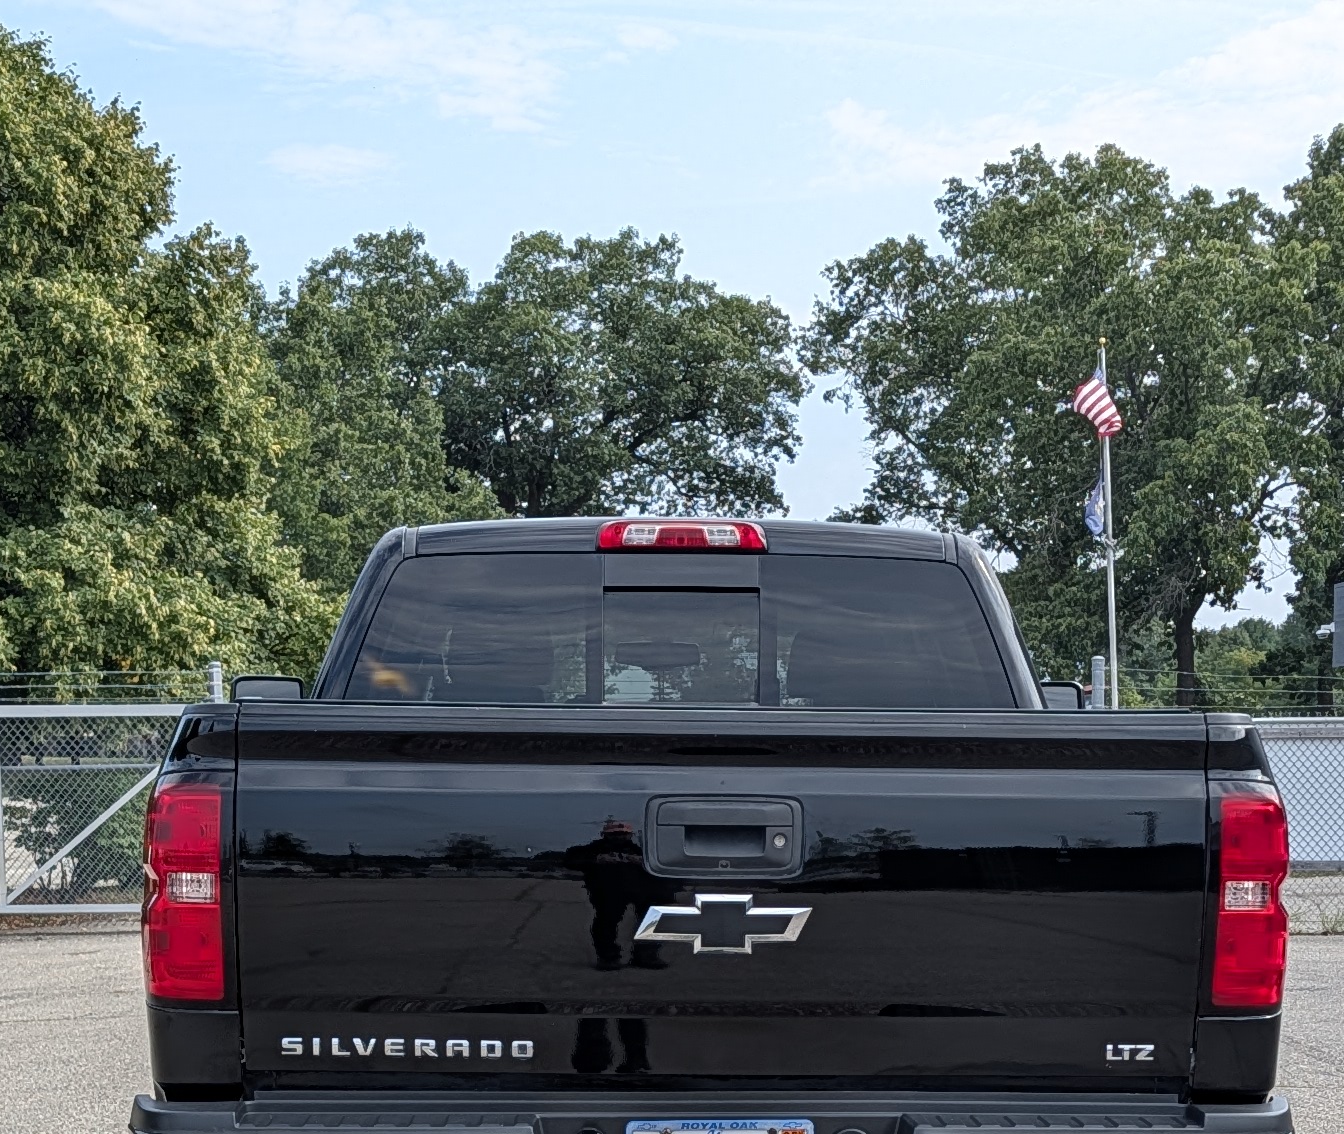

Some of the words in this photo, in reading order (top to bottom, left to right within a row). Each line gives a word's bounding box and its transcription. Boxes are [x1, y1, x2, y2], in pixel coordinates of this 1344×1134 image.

[281, 1037, 534, 1058] SILVERADO
[1106, 1044, 1155, 1060] LTZ
[681, 1122, 725, 1130] ROYAL
[730, 1121, 759, 1129] OAK
